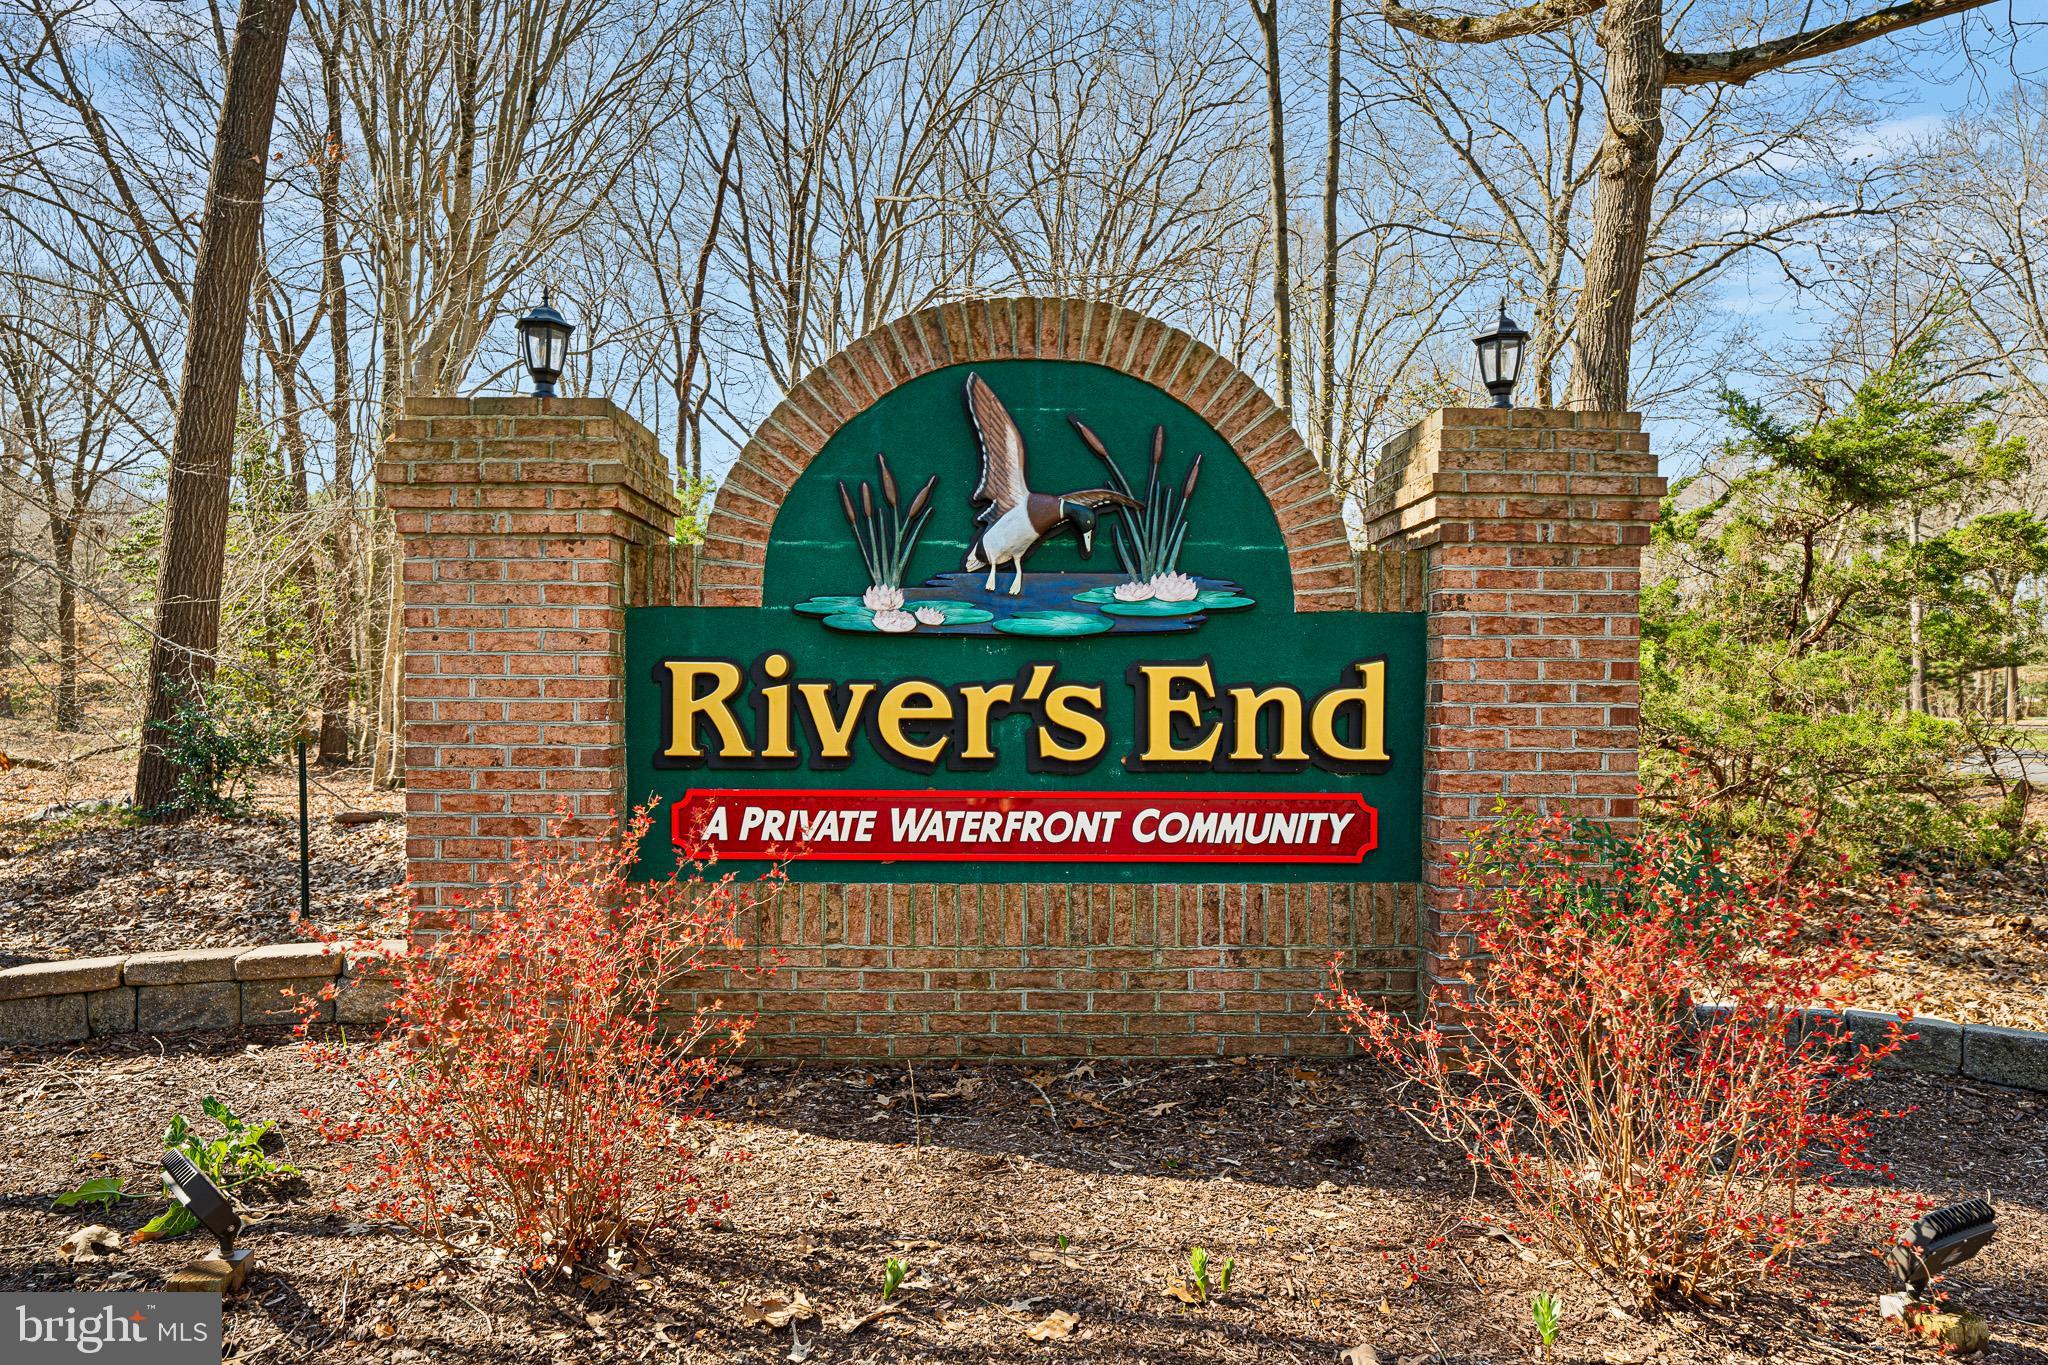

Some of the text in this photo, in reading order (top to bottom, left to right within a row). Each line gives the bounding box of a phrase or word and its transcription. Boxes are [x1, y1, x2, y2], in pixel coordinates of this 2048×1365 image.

[663, 653, 1391, 763] River's End
[700, 805, 1356, 845] A PRIVATE WATERFRONT COMMUNITY
